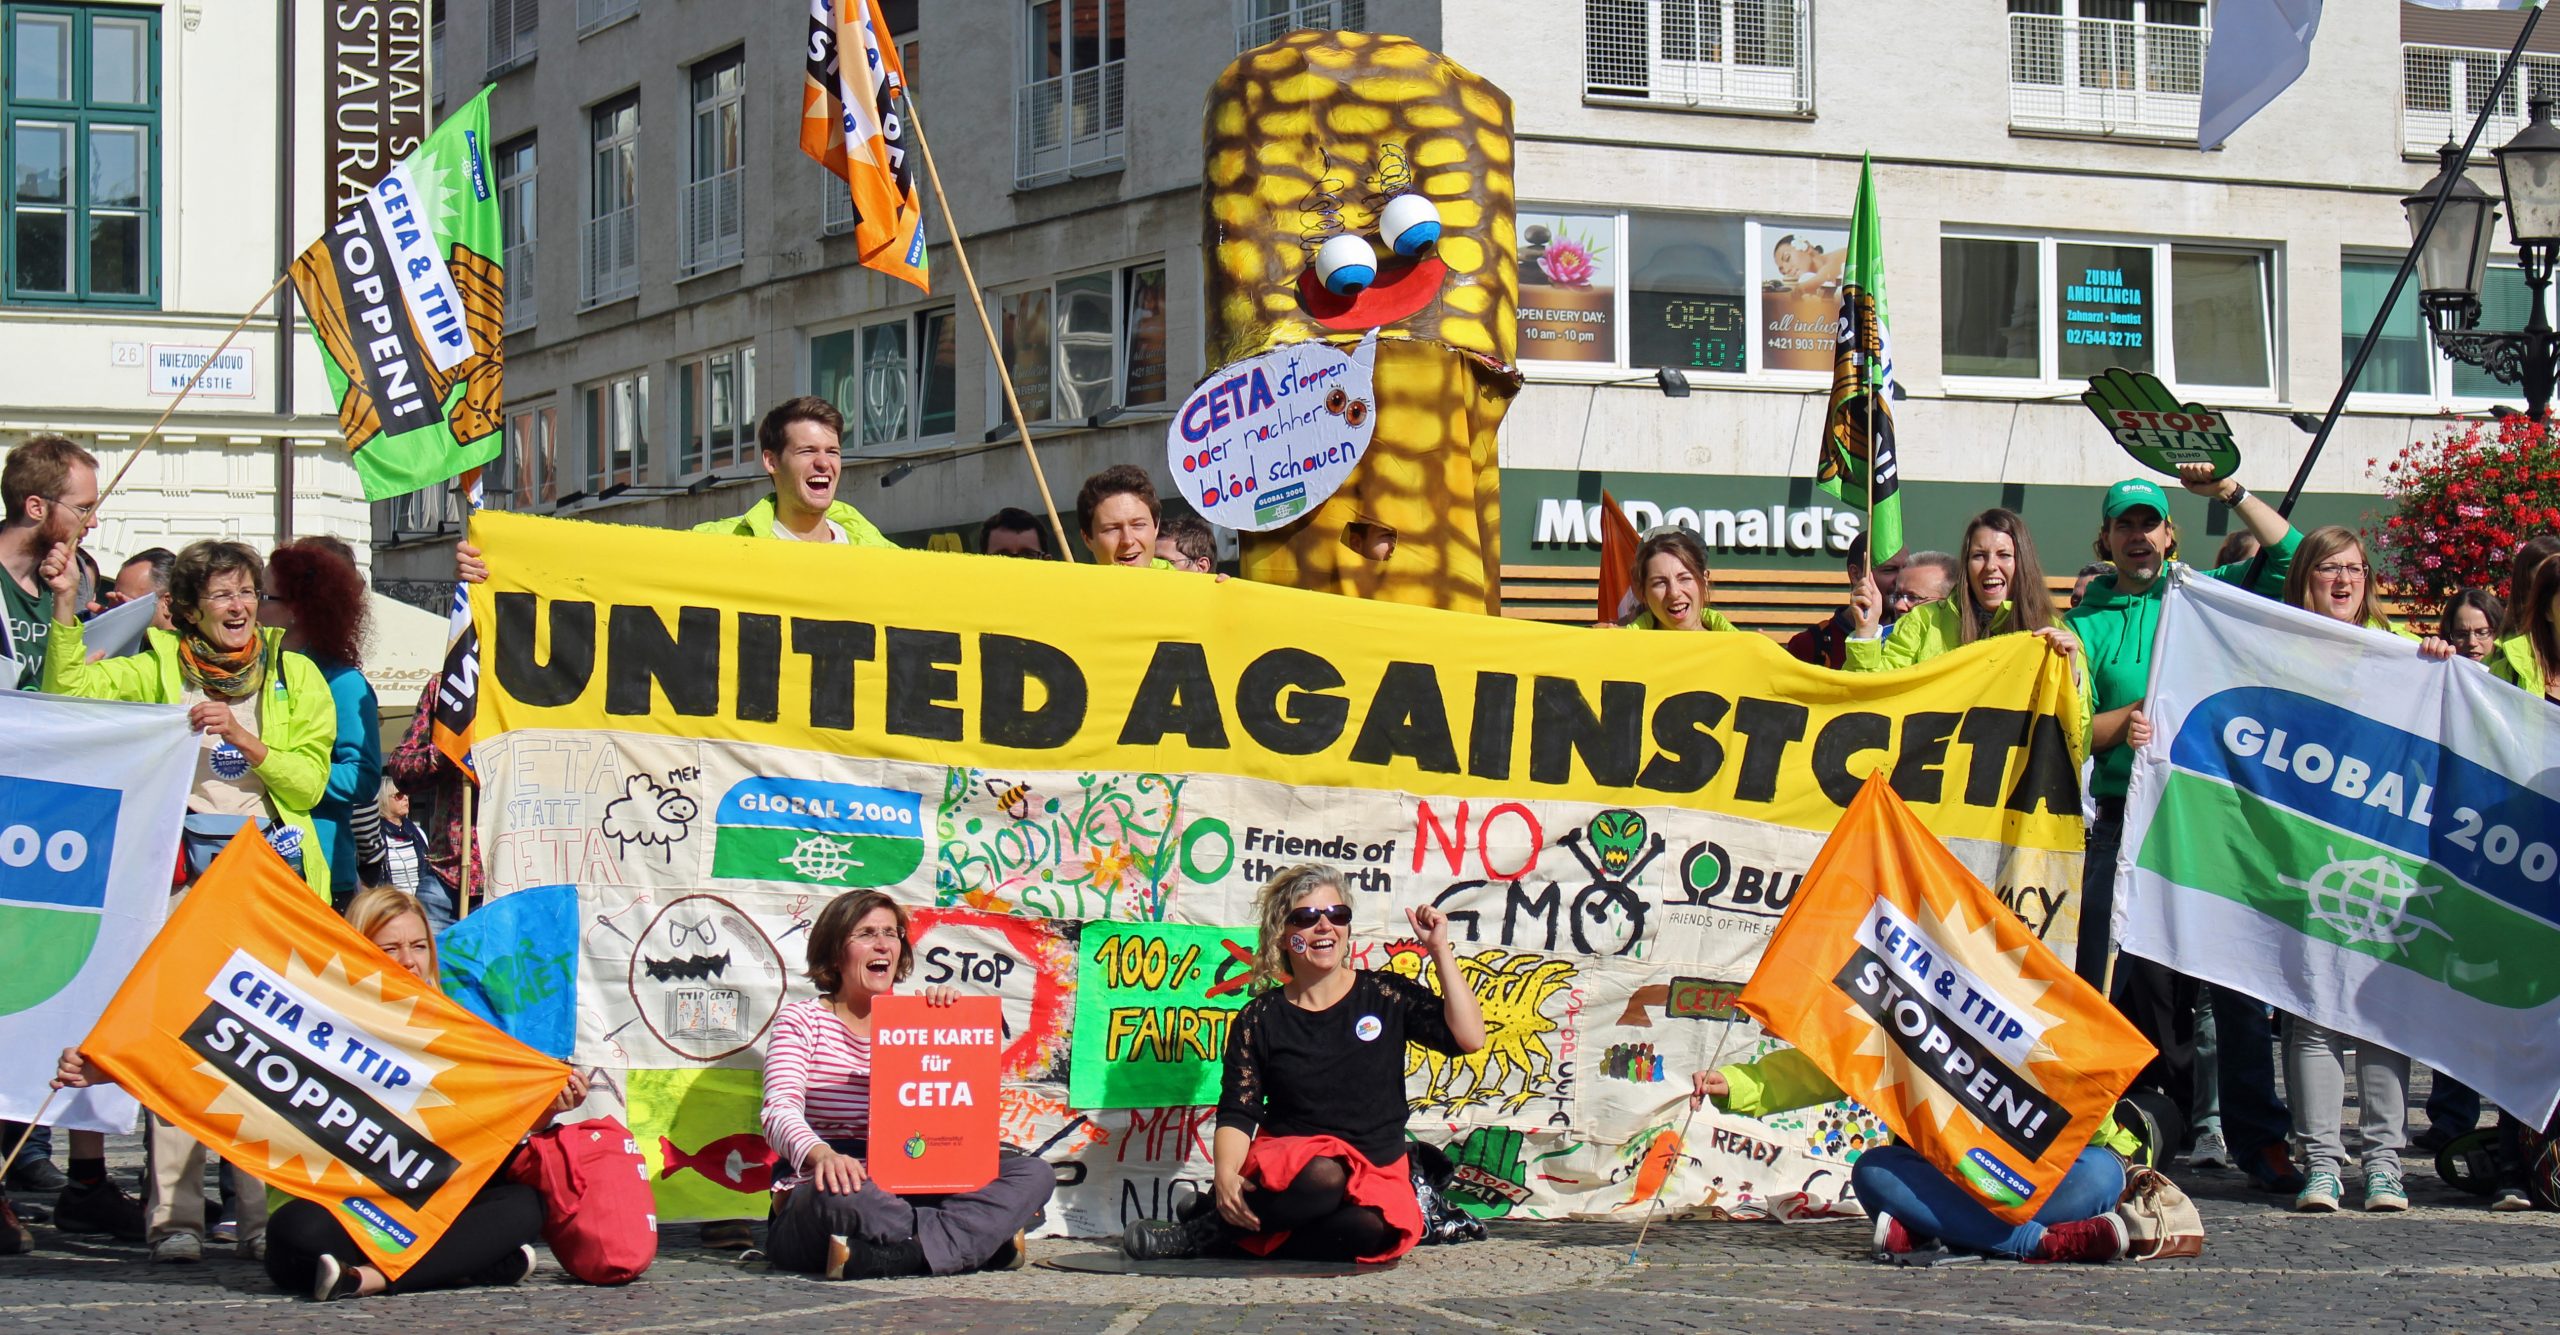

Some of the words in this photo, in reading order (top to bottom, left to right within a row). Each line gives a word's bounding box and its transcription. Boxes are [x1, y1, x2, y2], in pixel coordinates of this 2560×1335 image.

[337, 0, 379, 220] STAURA
[474, 173, 486, 198] 2000
[378, 177, 421, 251] CETA
[407, 256, 431, 280] &
[419, 282, 462, 350] TTIP
[2086, 268, 2122, 286] ZUBNÁ
[334, 209, 424, 418] TOPPEN!
[2067, 286, 2141, 305] AMBULANCIA
[1525, 328, 1538, 340] 10
[1540, 331, 1555, 341] am
[1563, 329, 1576, 341] 10
[1577, 333, 1594, 345] pm
[1546, 310, 1580, 322] EVERY
[1582, 311, 1606, 323] DAY:
[1769, 314, 1793, 333] all
[2067, 310, 2104, 322] Zahnarzt
[2110, 312, 2141, 324] Dentist
[118, 347, 137, 362] 26
[1768, 338, 1793, 351] +421
[1795, 339, 1814, 352] 903
[1816, 341, 1835, 353] 777
[2067, 329, 2106, 344] 02/544
[2109, 332, 2122, 345] 32
[2124, 333, 2141, 346] 712
[1181, 367, 1275, 443] CETA
[1277, 357, 1347, 397] stoppen
[1183, 437, 1232, 472] oder
[1244, 403, 1324, 449] nachher
[2115, 429, 2222, 450] CETA!
[2118, 411, 2217, 432] STOP
[1200, 454, 1258, 508] blöd
[1269, 440, 1356, 481] schauen
[1259, 493, 1284, 506] GLOBAL
[1286, 487, 1304, 497] 2000
[494, 592, 1089, 750] UNITED
[1117, 641, 1809, 802] AGAINST
[1812, 705, 2083, 816] CETA
[479, 739, 626, 803] FETA
[507, 799, 581, 829] STATT
[738, 793, 840, 819] GLOBAL
[848, 802, 912, 825] 2000
[2223, 716, 2435, 827] GLOBAL
[2444, 807, 2560, 884] 200
[1245, 827, 1358, 861] Friends
[1363, 839, 1396, 864] of
[1412, 801, 1543, 881] NO
[488, 828, 624, 898] CETA
[1669, 912, 1713, 928] FRIENDS
[1718, 916, 1734, 930] OF
[1737, 919, 1761, 933] THE
[925, 946, 1015, 989] STOP
[1094, 935, 1201, 991] 100%
[1874, 915, 1931, 981] CETA
[1934, 970, 1957, 1001] &
[1960, 988, 2024, 1044] TTIP
[1676, 986, 1737, 1014] CETA
[229, 970, 303, 1041] CETA
[307, 1020, 334, 1050] &
[340, 1037, 411, 1090] TTIP
[879, 1029, 928, 1046] ROTE
[933, 1029, 994, 1045] KARTE
[1560, 989, 1585, 1061] STOP
[921, 1055, 952, 1072] für
[1855, 960, 2048, 1140] STOPPEN!
[204, 1017, 435, 1190] STOPPEN!
[898, 1082, 973, 1107] CETA
[1548, 1062, 1575, 1126] CETA
[1117, 1106, 1217, 1165] MAK
[1711, 1127, 1783, 1168] READY
[1459, 1168, 1522, 1198] STOP!
[1974, 1151, 2007, 1179] GLOBAL
[2006, 1175, 2031, 1196] 2000
[351, 1200, 386, 1229] GLOBAL
[386, 1224, 411, 1245] 2000
